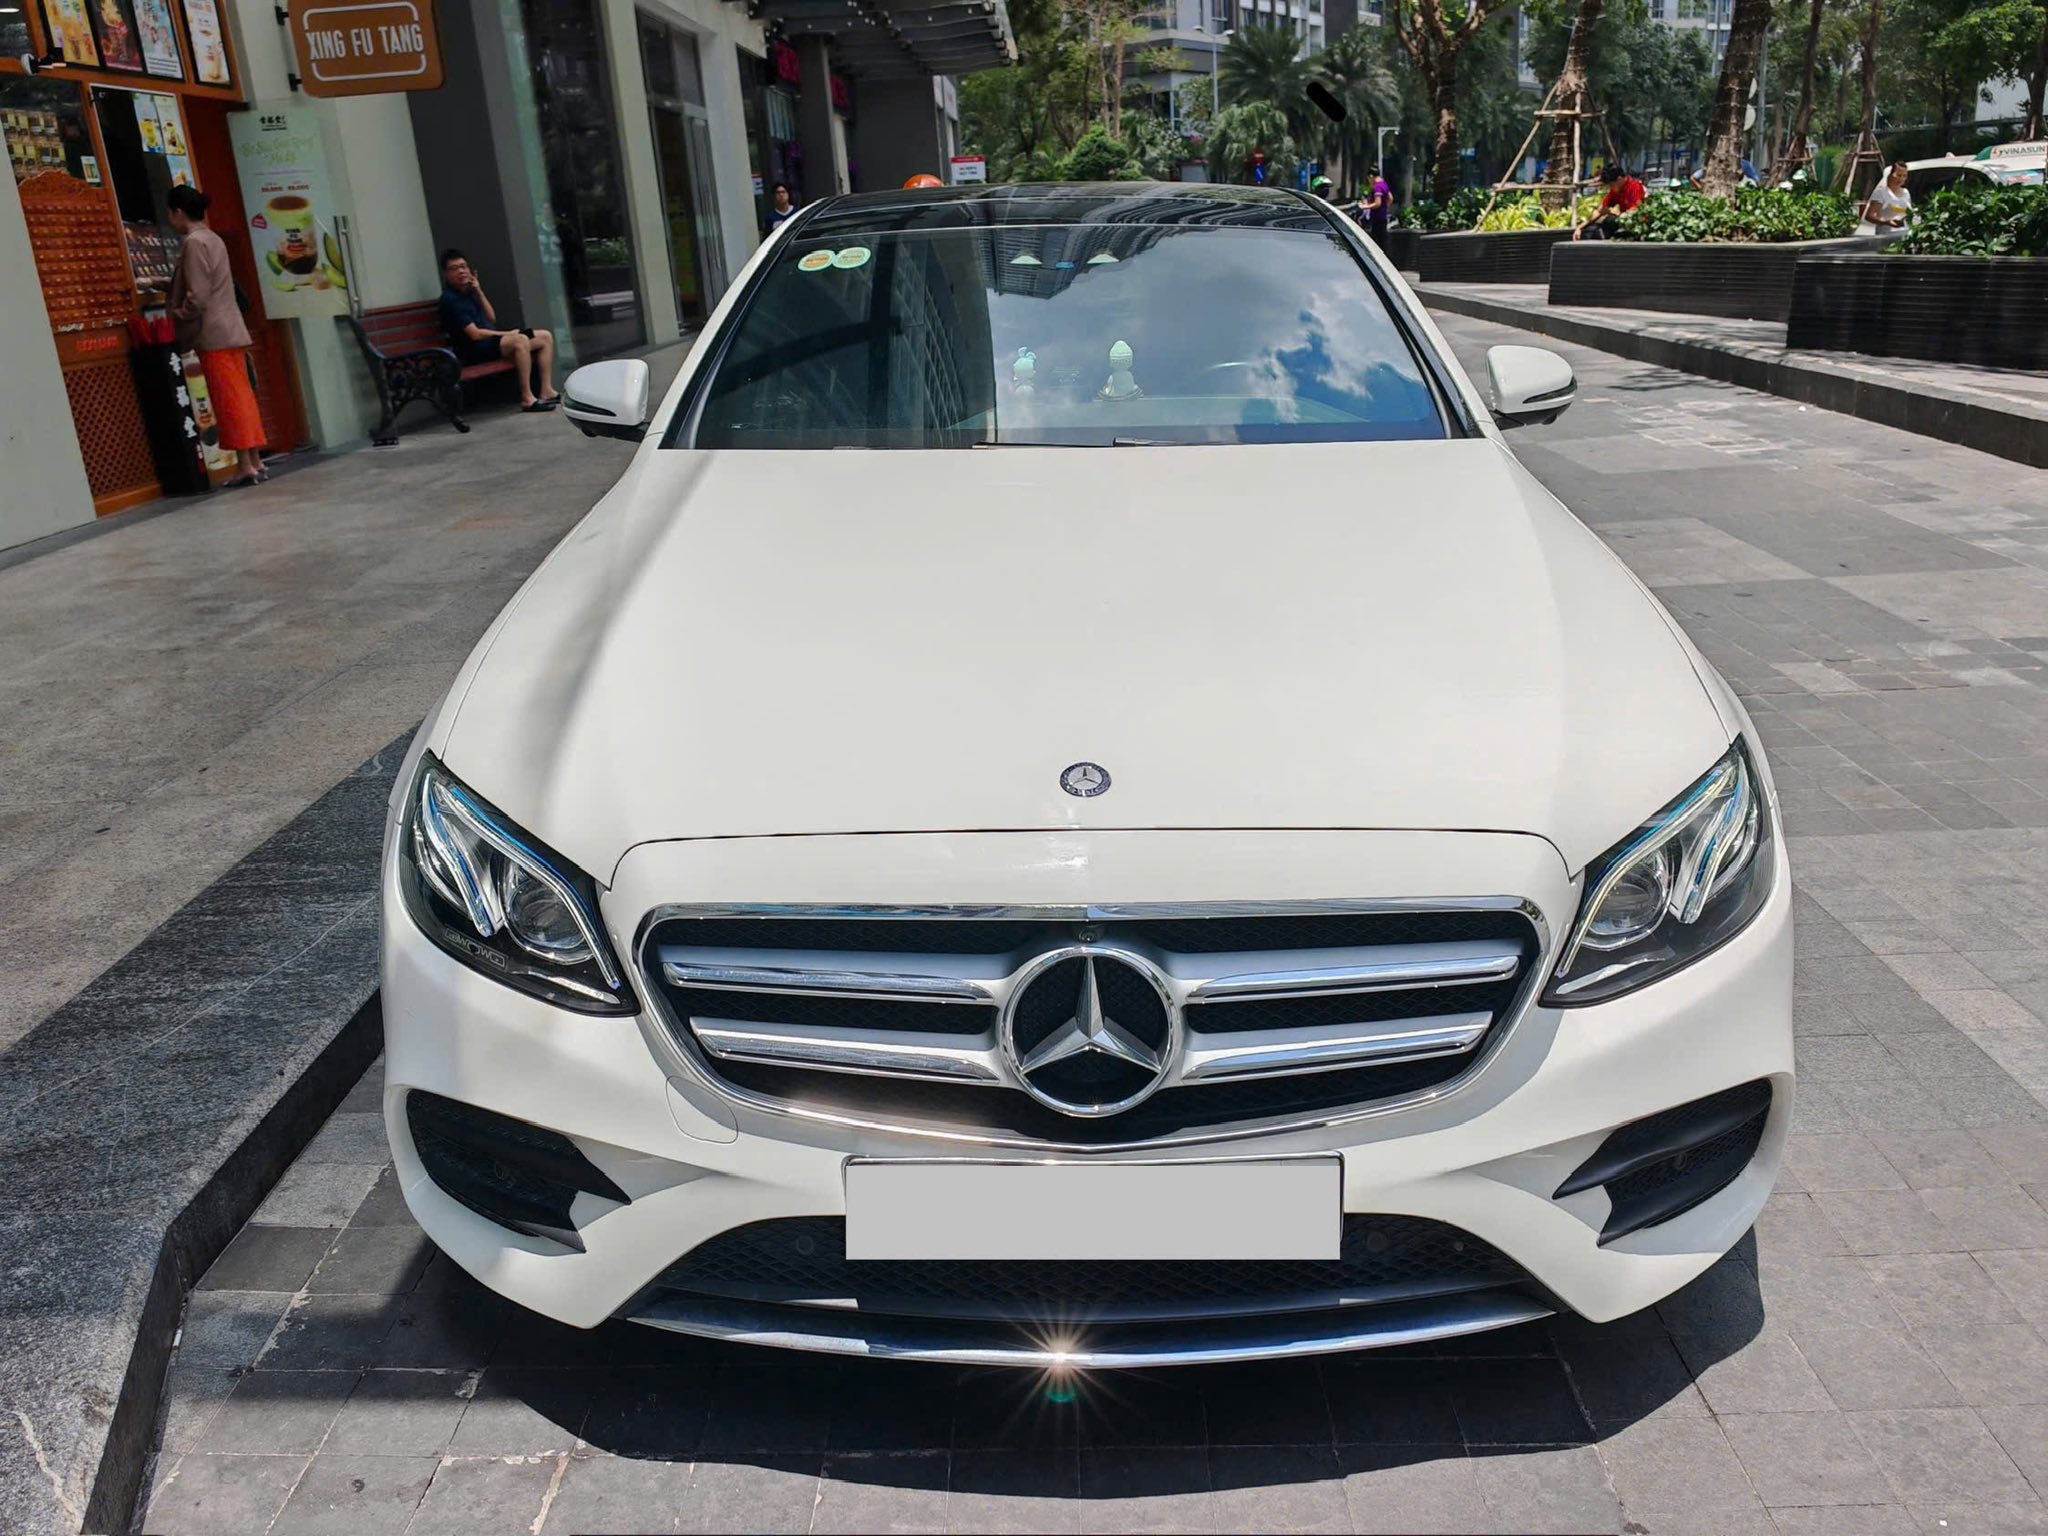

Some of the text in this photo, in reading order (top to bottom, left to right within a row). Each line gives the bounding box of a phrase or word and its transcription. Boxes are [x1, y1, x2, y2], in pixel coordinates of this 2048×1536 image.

[306, 24, 424, 60] XING FU TANG
[2003, 146, 2045, 154] VINASUN
